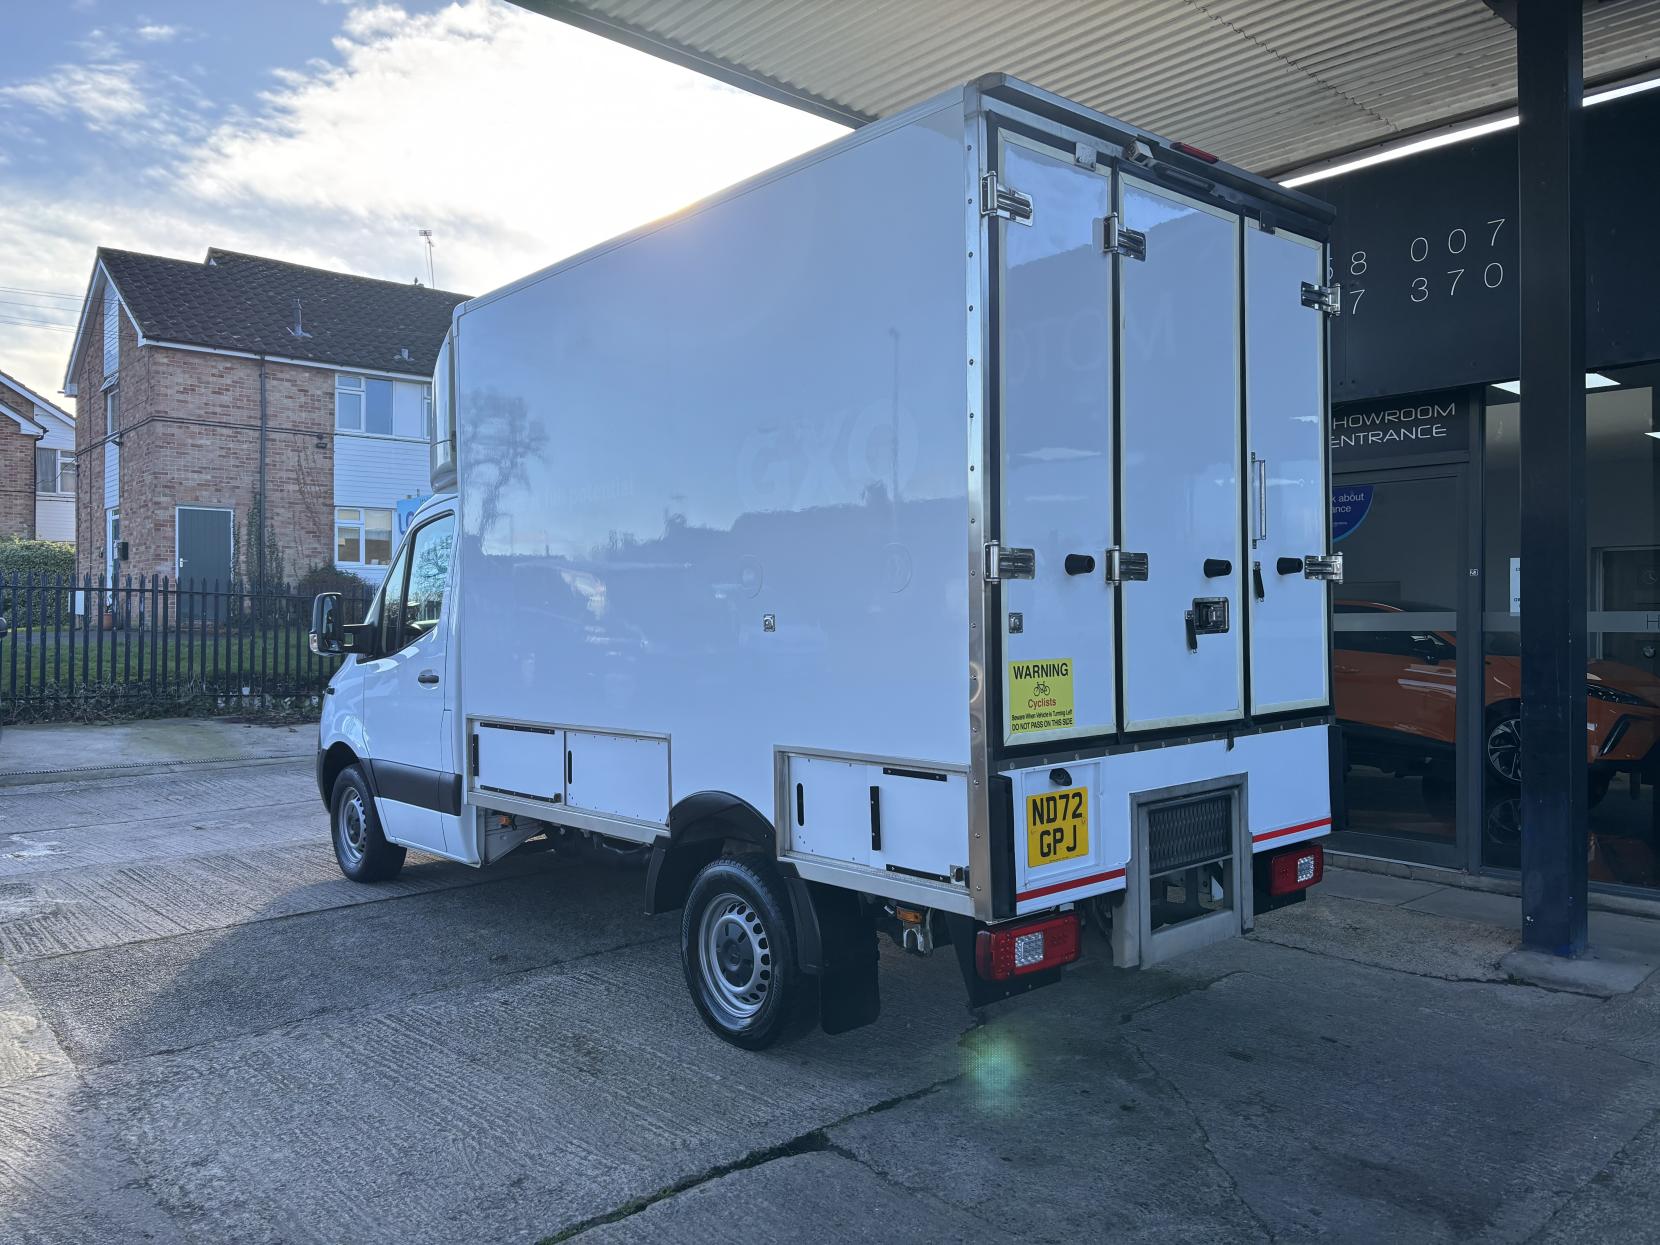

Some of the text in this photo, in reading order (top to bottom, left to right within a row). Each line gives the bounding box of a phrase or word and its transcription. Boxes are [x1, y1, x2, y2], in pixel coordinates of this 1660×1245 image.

[1410, 262, 1504, 302] 370
[1331, 424, 1448, 448] ENTRANCE
[1339, 493, 1365, 502] about
[1013, 663, 1069, 680] WARNING
[1028, 698, 1057, 711] Cyclists
[1025, 712, 1036, 720] When
[1036, 711, 1049, 719] Vehicle
[1011, 723, 1020, 731] DO
[1020, 721, 1030, 730] NOT
[1031, 721, 1043, 729] PASS
[1062, 718, 1072, 726] SIDE
[1032, 791, 1083, 826] ND72
[1039, 824, 1077, 858] GPJ
